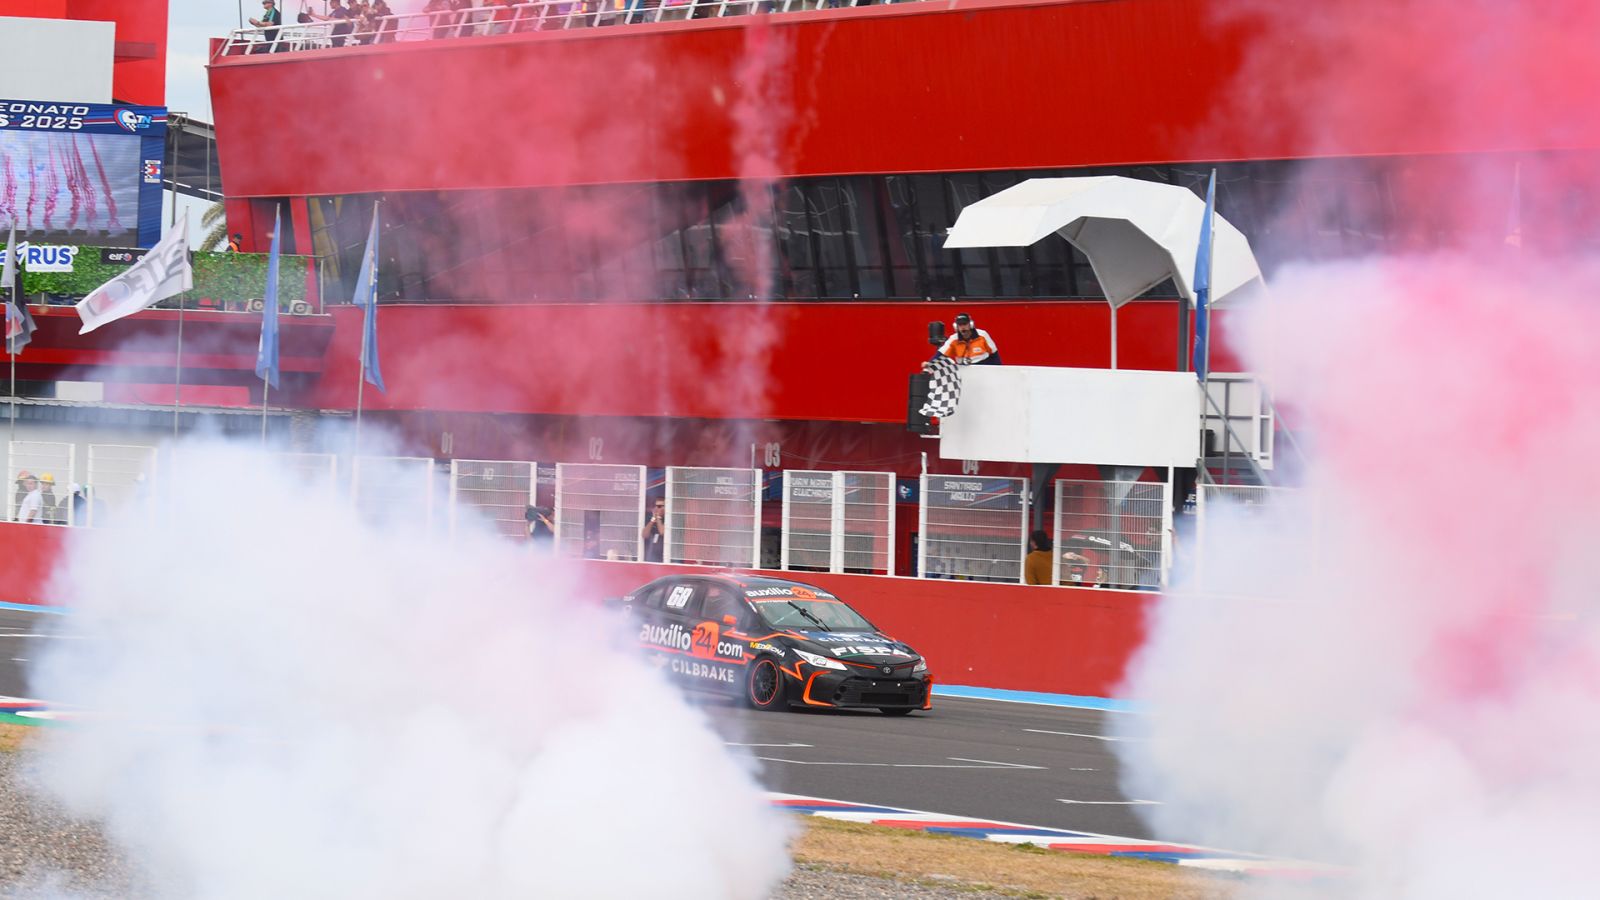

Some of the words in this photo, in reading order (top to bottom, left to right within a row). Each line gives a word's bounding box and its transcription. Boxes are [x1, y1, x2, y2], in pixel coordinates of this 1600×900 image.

[20, 115, 83, 130] 2025
[441, 432, 454, 454] 01
[589, 437, 604, 460] 02
[764, 442, 780, 467] 03
[944, 481, 983, 491] SANTIAGO
[666, 586, 693, 608] 68
[671, 659, 735, 683] CILBRAKE
